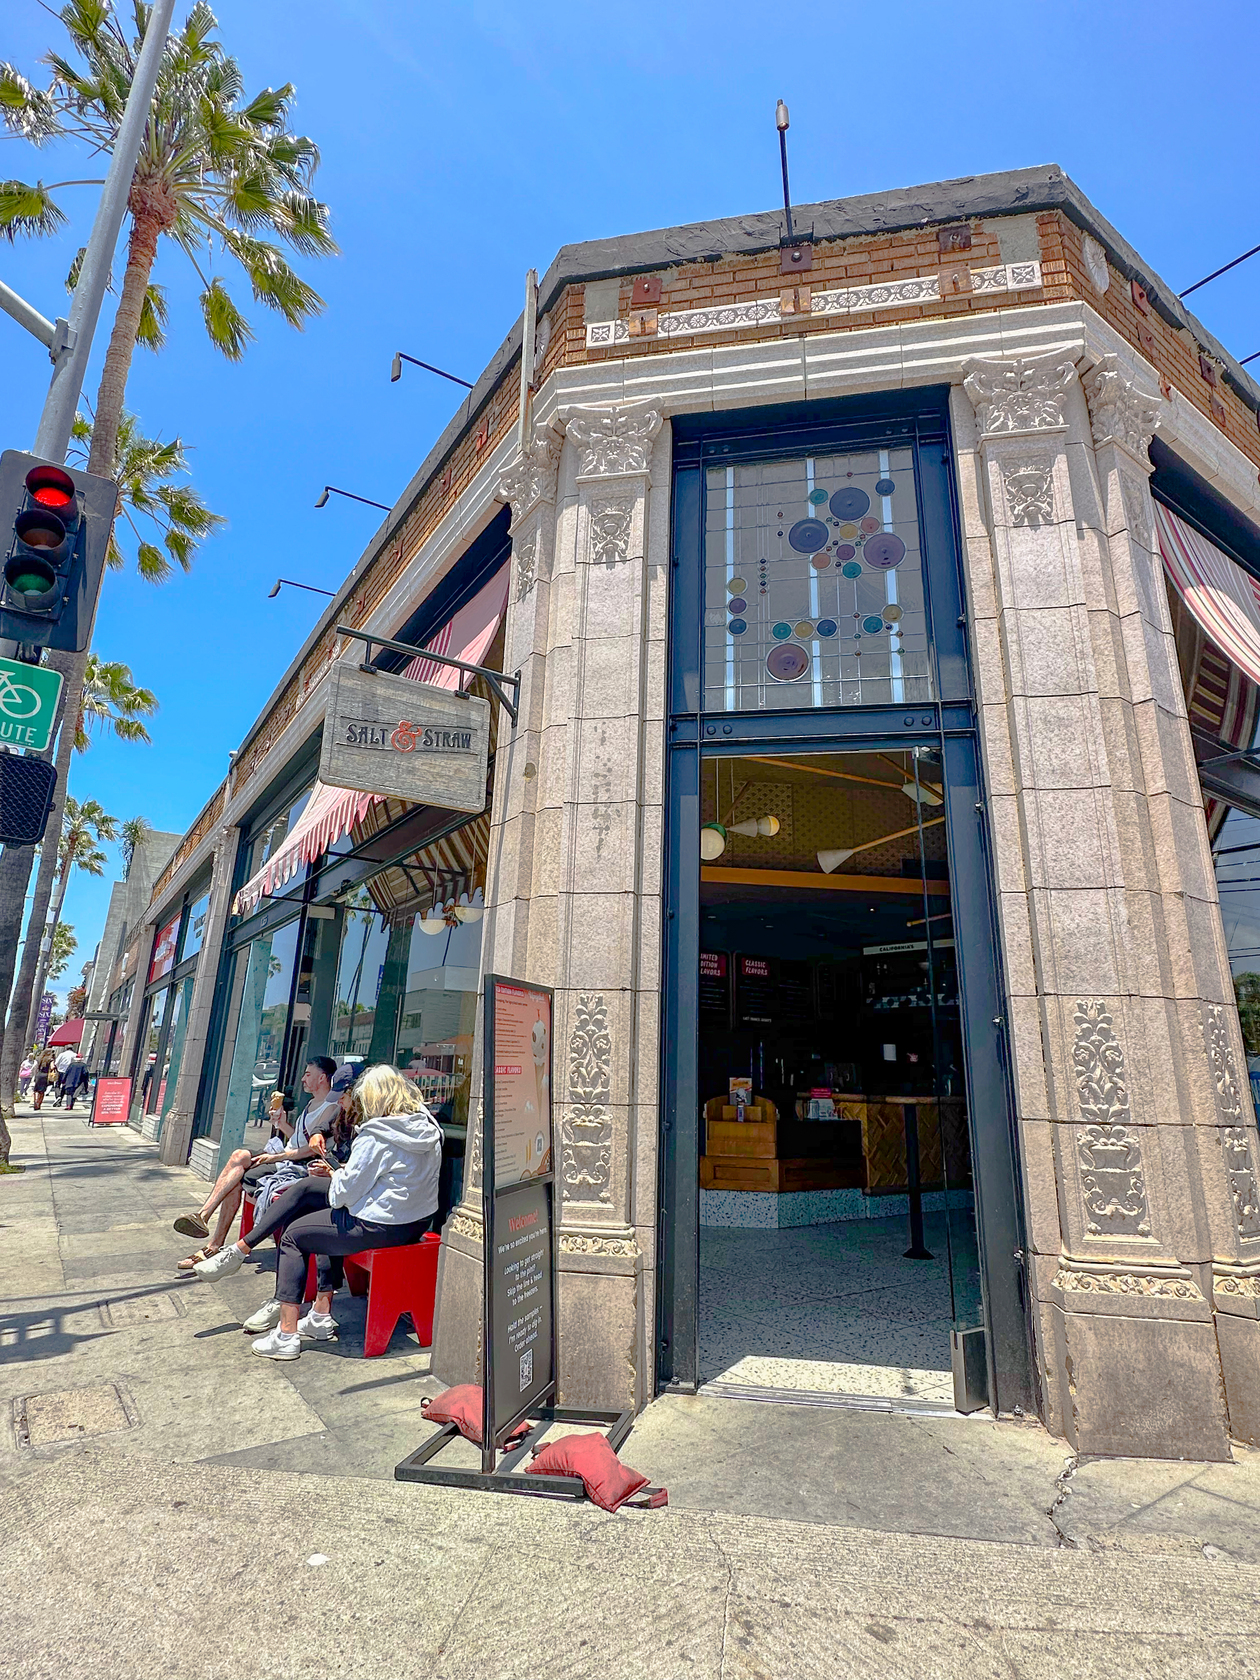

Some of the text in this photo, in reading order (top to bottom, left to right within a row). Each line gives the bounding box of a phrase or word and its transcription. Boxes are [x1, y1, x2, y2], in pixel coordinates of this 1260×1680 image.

[346, 720, 472, 753] SALT & STRAW
[880, 944, 914, 952] CALIFORNIA'S
[745, 960, 766, 968] CLASSIC
[746, 967, 768, 976] FLAVORS
[508, 1208, 539, 1232] Welcome!
[498, 1243, 510, 1254] We're
[510, 1240, 515, 1249] so
[516, 1235, 528, 1246] excited
[529, 1230, 540, 1242] you're
[504, 1261, 519, 1275] Looking
[507, 1287, 516, 1297] Skip
[534, 1271, 542, 1282] head
[508, 1320, 517, 1333] Hold
[525, 1307, 539, 1322] samples
[514, 1340, 526, 1352] Order
